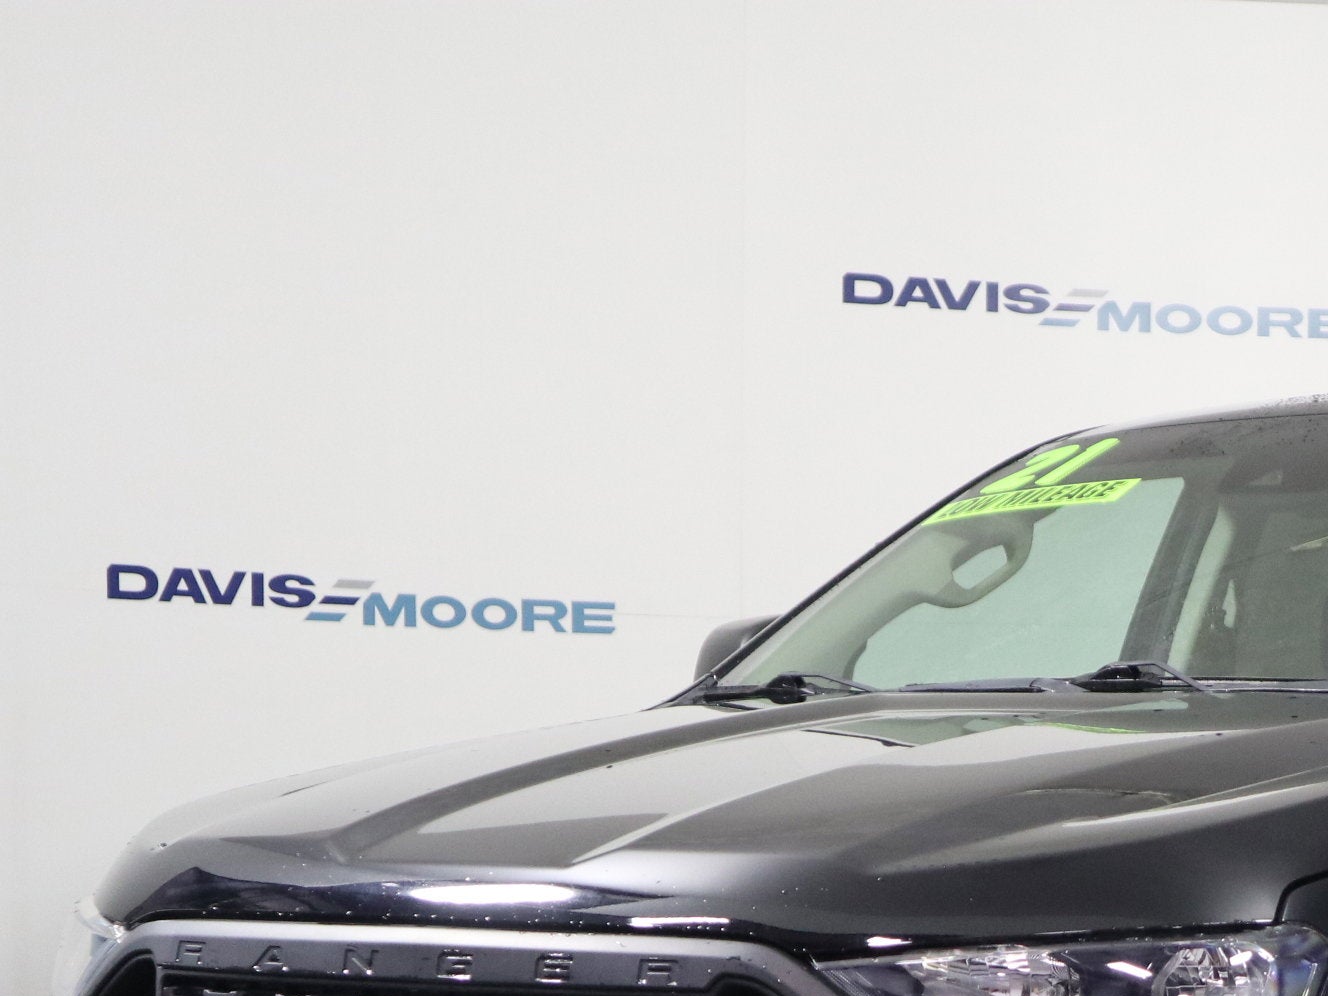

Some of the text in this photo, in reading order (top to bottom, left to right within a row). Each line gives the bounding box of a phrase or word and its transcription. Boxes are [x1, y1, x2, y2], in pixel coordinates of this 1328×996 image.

[841, 271, 1051, 315] DAVIS
[994, 480, 1129, 510] MILEAGE
[105, 563, 617, 635] DAVIS MOORE
[174, 939, 680, 986] RANGER
